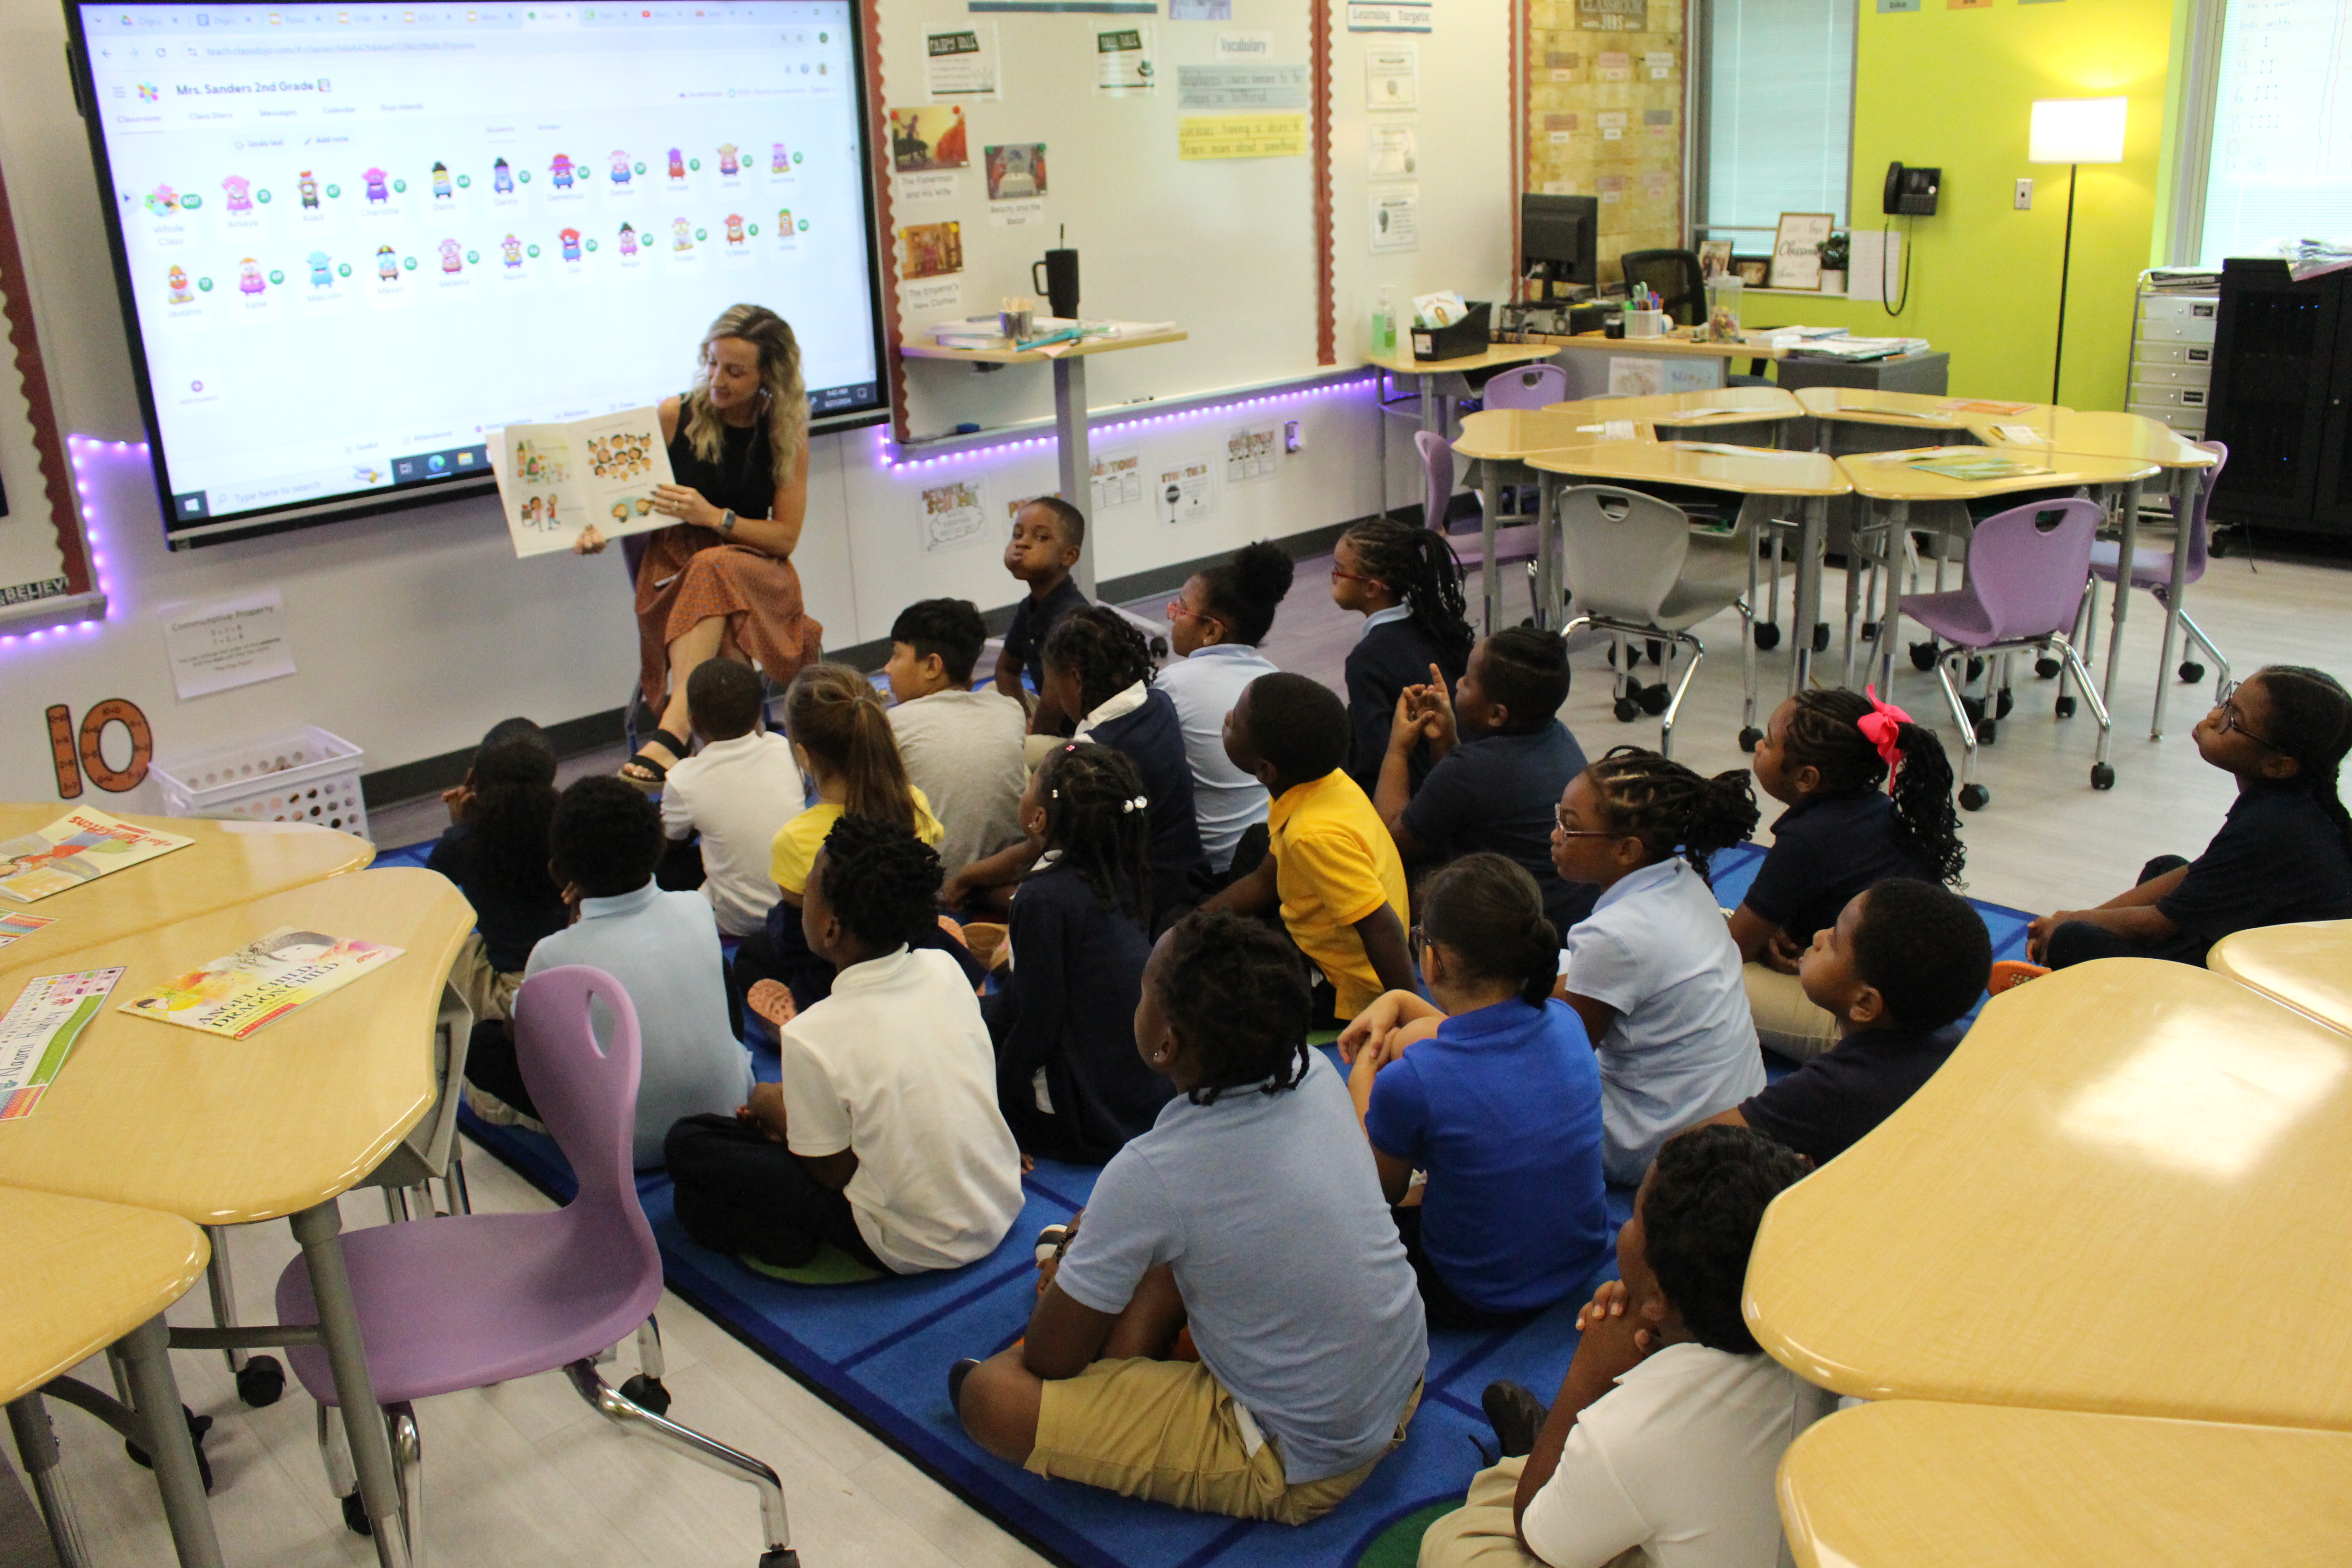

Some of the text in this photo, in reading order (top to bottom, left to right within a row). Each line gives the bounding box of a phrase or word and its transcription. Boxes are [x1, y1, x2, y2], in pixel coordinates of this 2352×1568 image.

[1352, 9, 1391, 23] Learning
[2265, 16, 2290, 27] with
[1220, 37, 1267, 54] Vocabulary
[2240, 37, 2248, 52] 2
[2238, 60, 2248, 75] 4
[176, 80, 314, 96] Mrs. Sanders 2nd Grade
[2234, 85, 2243, 104] 6
[259, 108, 298, 118] Messages
[322, 106, 357, 114] Calendar
[117, 114, 162, 124] Classroom
[188, 111, 234, 121] Class Story
[485, 125, 516, 134] Students
[536, 123, 561, 132] Groups
[2230, 115, 2241, 134] 8
[247, 138, 284, 148] Undo last
[332, 135, 349, 143] note
[916, 174, 953, 183] Fisherman
[906, 191, 920, 199] and
[361, 207, 400, 217] Charlotte
[990, 203, 1041, 214] Beauty and the
[1006, 216, 1026, 226] Beast
[153, 224, 185, 235] Whole
[158, 236, 184, 247] Class
[908, 282, 959, 297] The Emperor's
[913, 296, 957, 310] New Clothes
[172, 605, 274, 632] Commutative Property
[45, 697, 153, 799] 10
[198, 965, 320, 1025] ANGEL CHILD,
[211, 962, 339, 1028] DRAGON CHILD
[244, 1003, 292, 1031] SCHOLASTIC
[0, 1043, 34, 1077] Naomi
